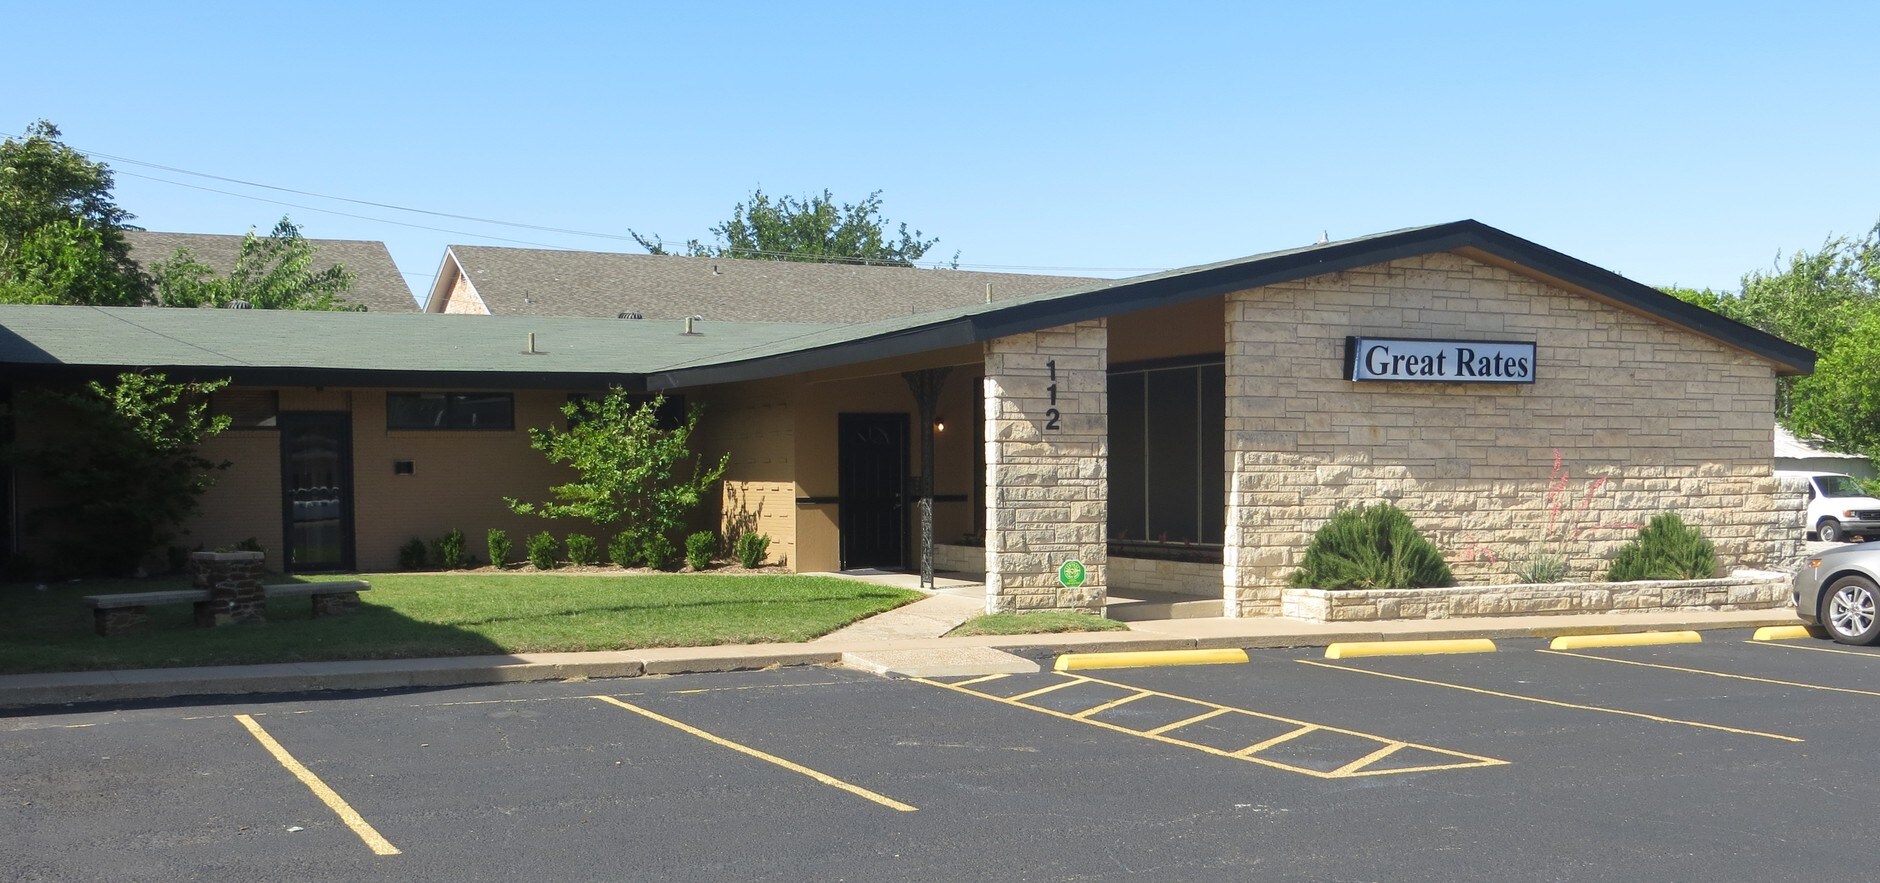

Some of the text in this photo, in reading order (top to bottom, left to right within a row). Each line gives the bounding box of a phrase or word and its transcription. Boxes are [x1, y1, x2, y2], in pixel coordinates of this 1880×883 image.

[1365, 345, 1528, 378] Great Rates
[1046, 360, 1060, 430] 112
